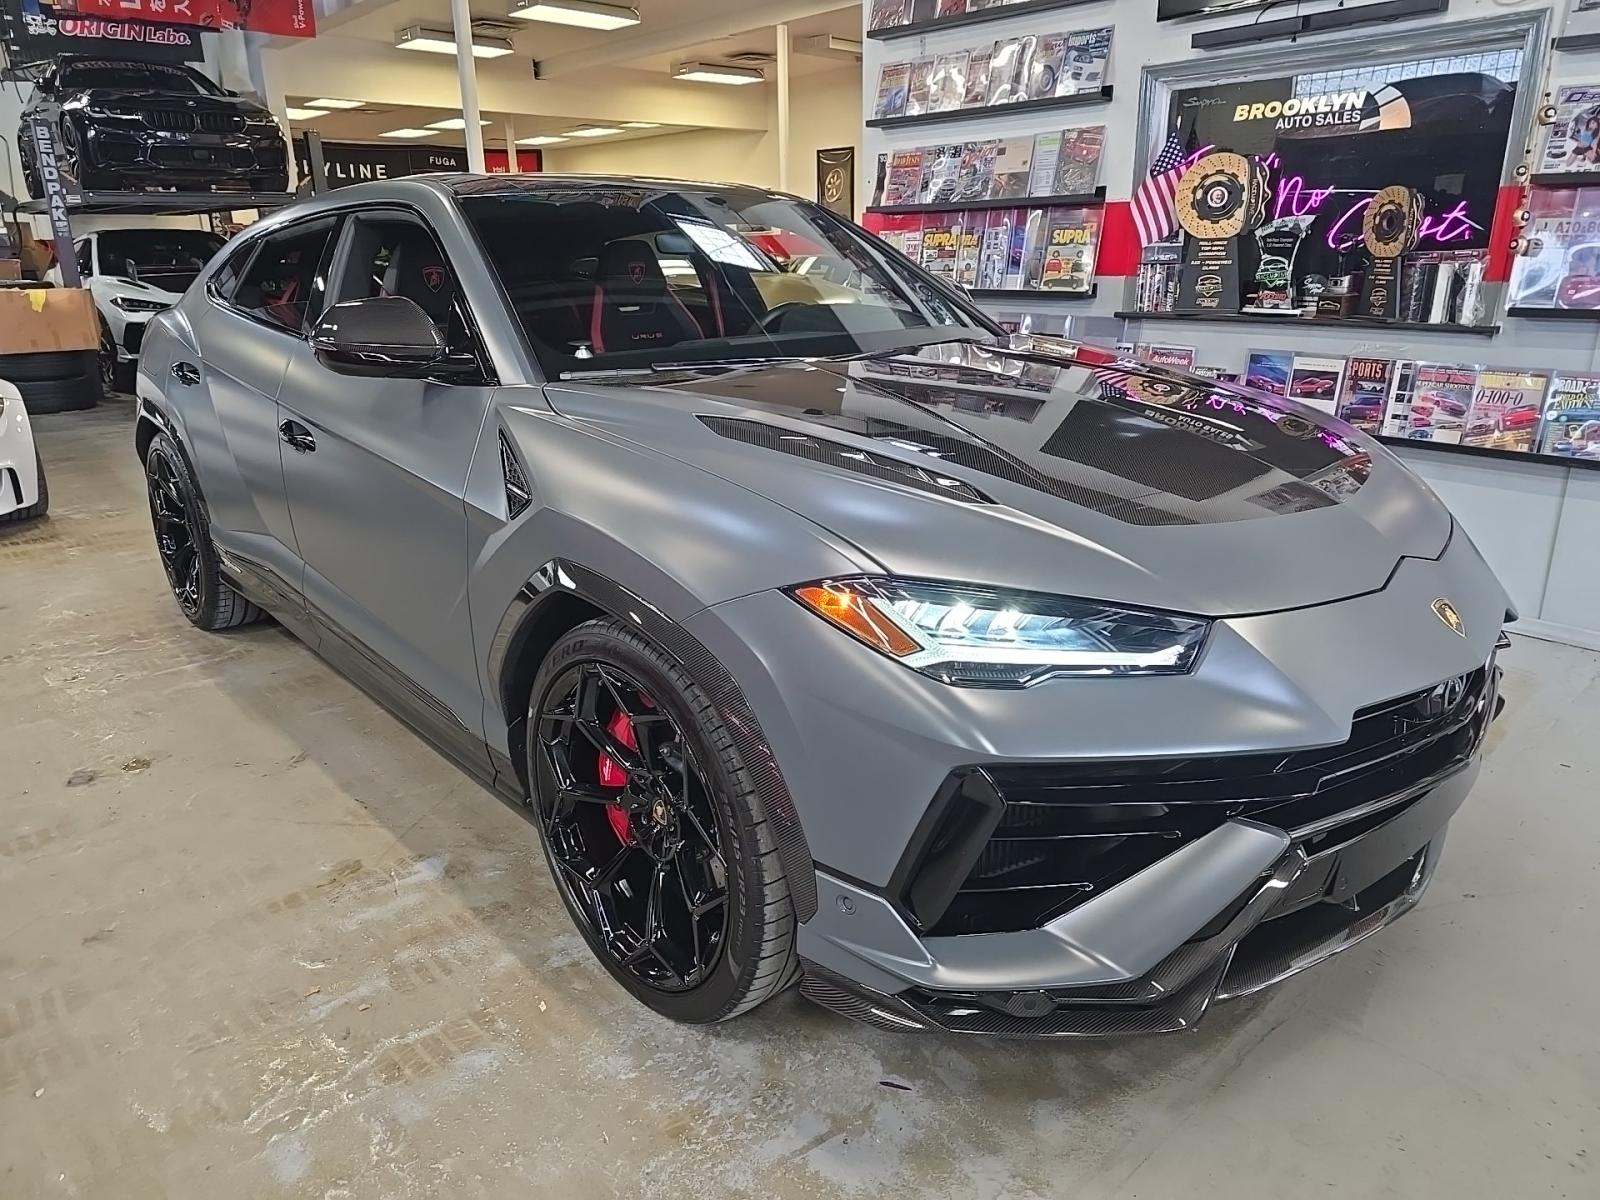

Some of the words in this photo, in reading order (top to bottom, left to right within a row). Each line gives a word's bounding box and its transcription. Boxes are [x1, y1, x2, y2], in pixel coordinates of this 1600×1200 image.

[59, 19, 145, 42] ORIGIN
[146, 26, 192, 45] Labo.
[1233, 90, 1367, 122] BROOKLYN
[1275, 114, 1314, 130] AUTO
[1315, 110, 1362, 127] SALES
[429, 156, 457, 167] FUGA
[36, 126, 67, 221] BENDPAK
[1275, 176, 1336, 219] No
[923, 232, 956, 248] SUPRA
[1052, 229, 1091, 244] SUPRA
[1151, 354, 1191, 367] AutoWeek
[1475, 389, 1524, 407] 0-100-0
